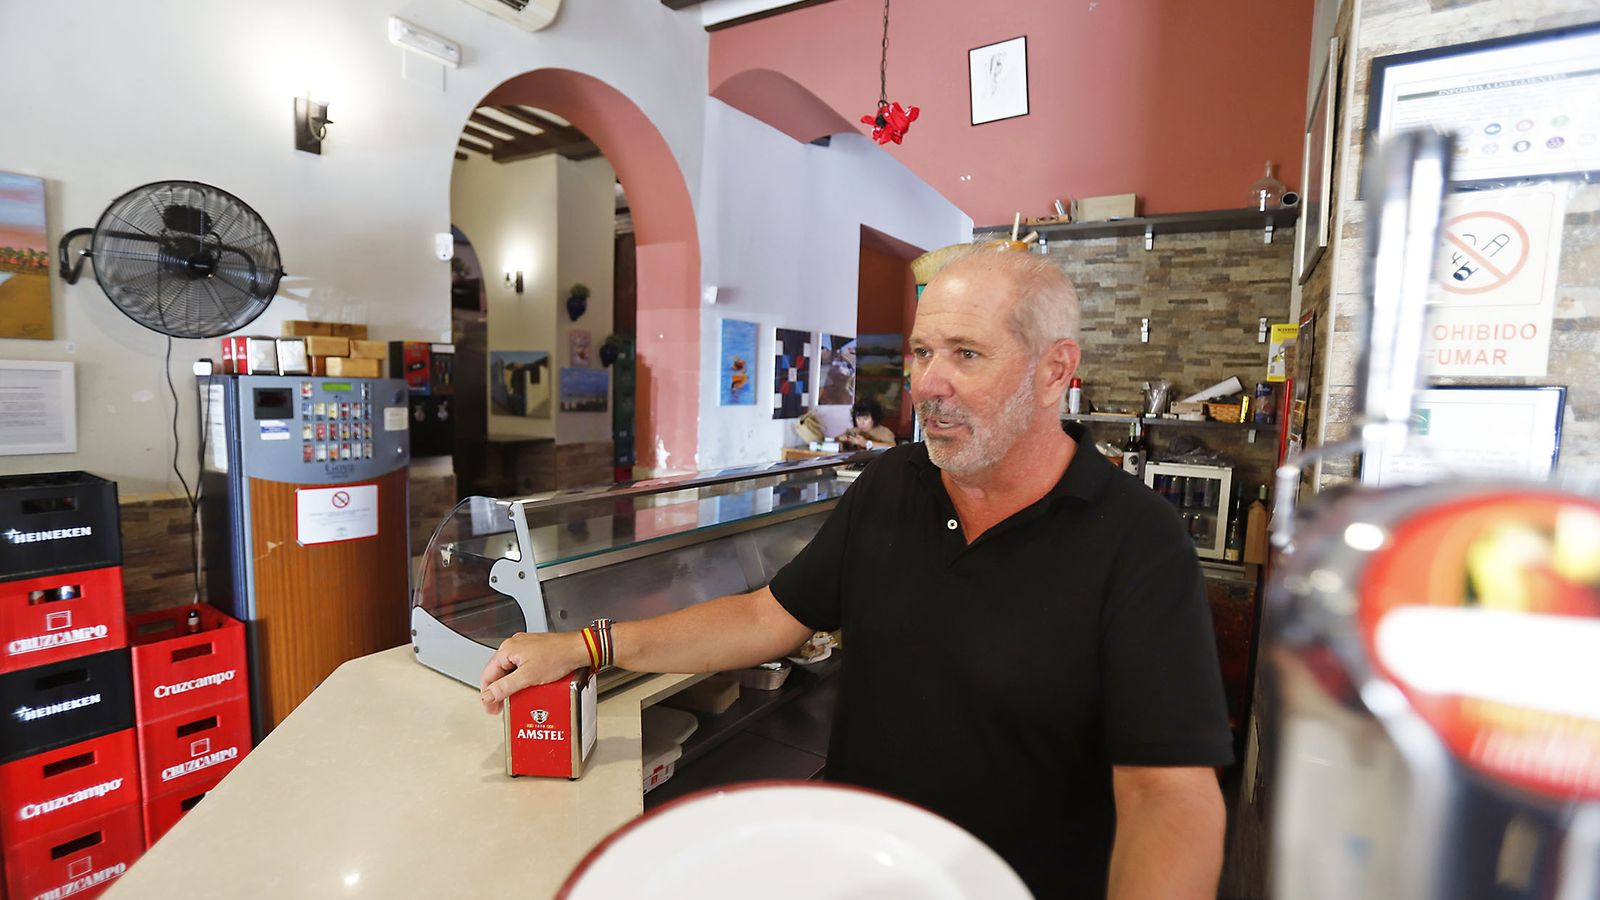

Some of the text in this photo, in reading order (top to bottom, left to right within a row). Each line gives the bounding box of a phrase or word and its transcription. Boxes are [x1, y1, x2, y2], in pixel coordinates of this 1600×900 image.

[1433, 323, 1537, 341] OHIBIDO
[14, 526, 92, 543] HEINEKEN
[8, 624, 108, 654] CRUZCAMPO
[153, 670, 236, 698] Cruzcampo
[25, 693, 101, 721] HEINEKEN
[517, 728, 564, 741] AMSTEL
[161, 746, 238, 780] CRUZCAMPO
[20, 777, 123, 820] Cruzcampo
